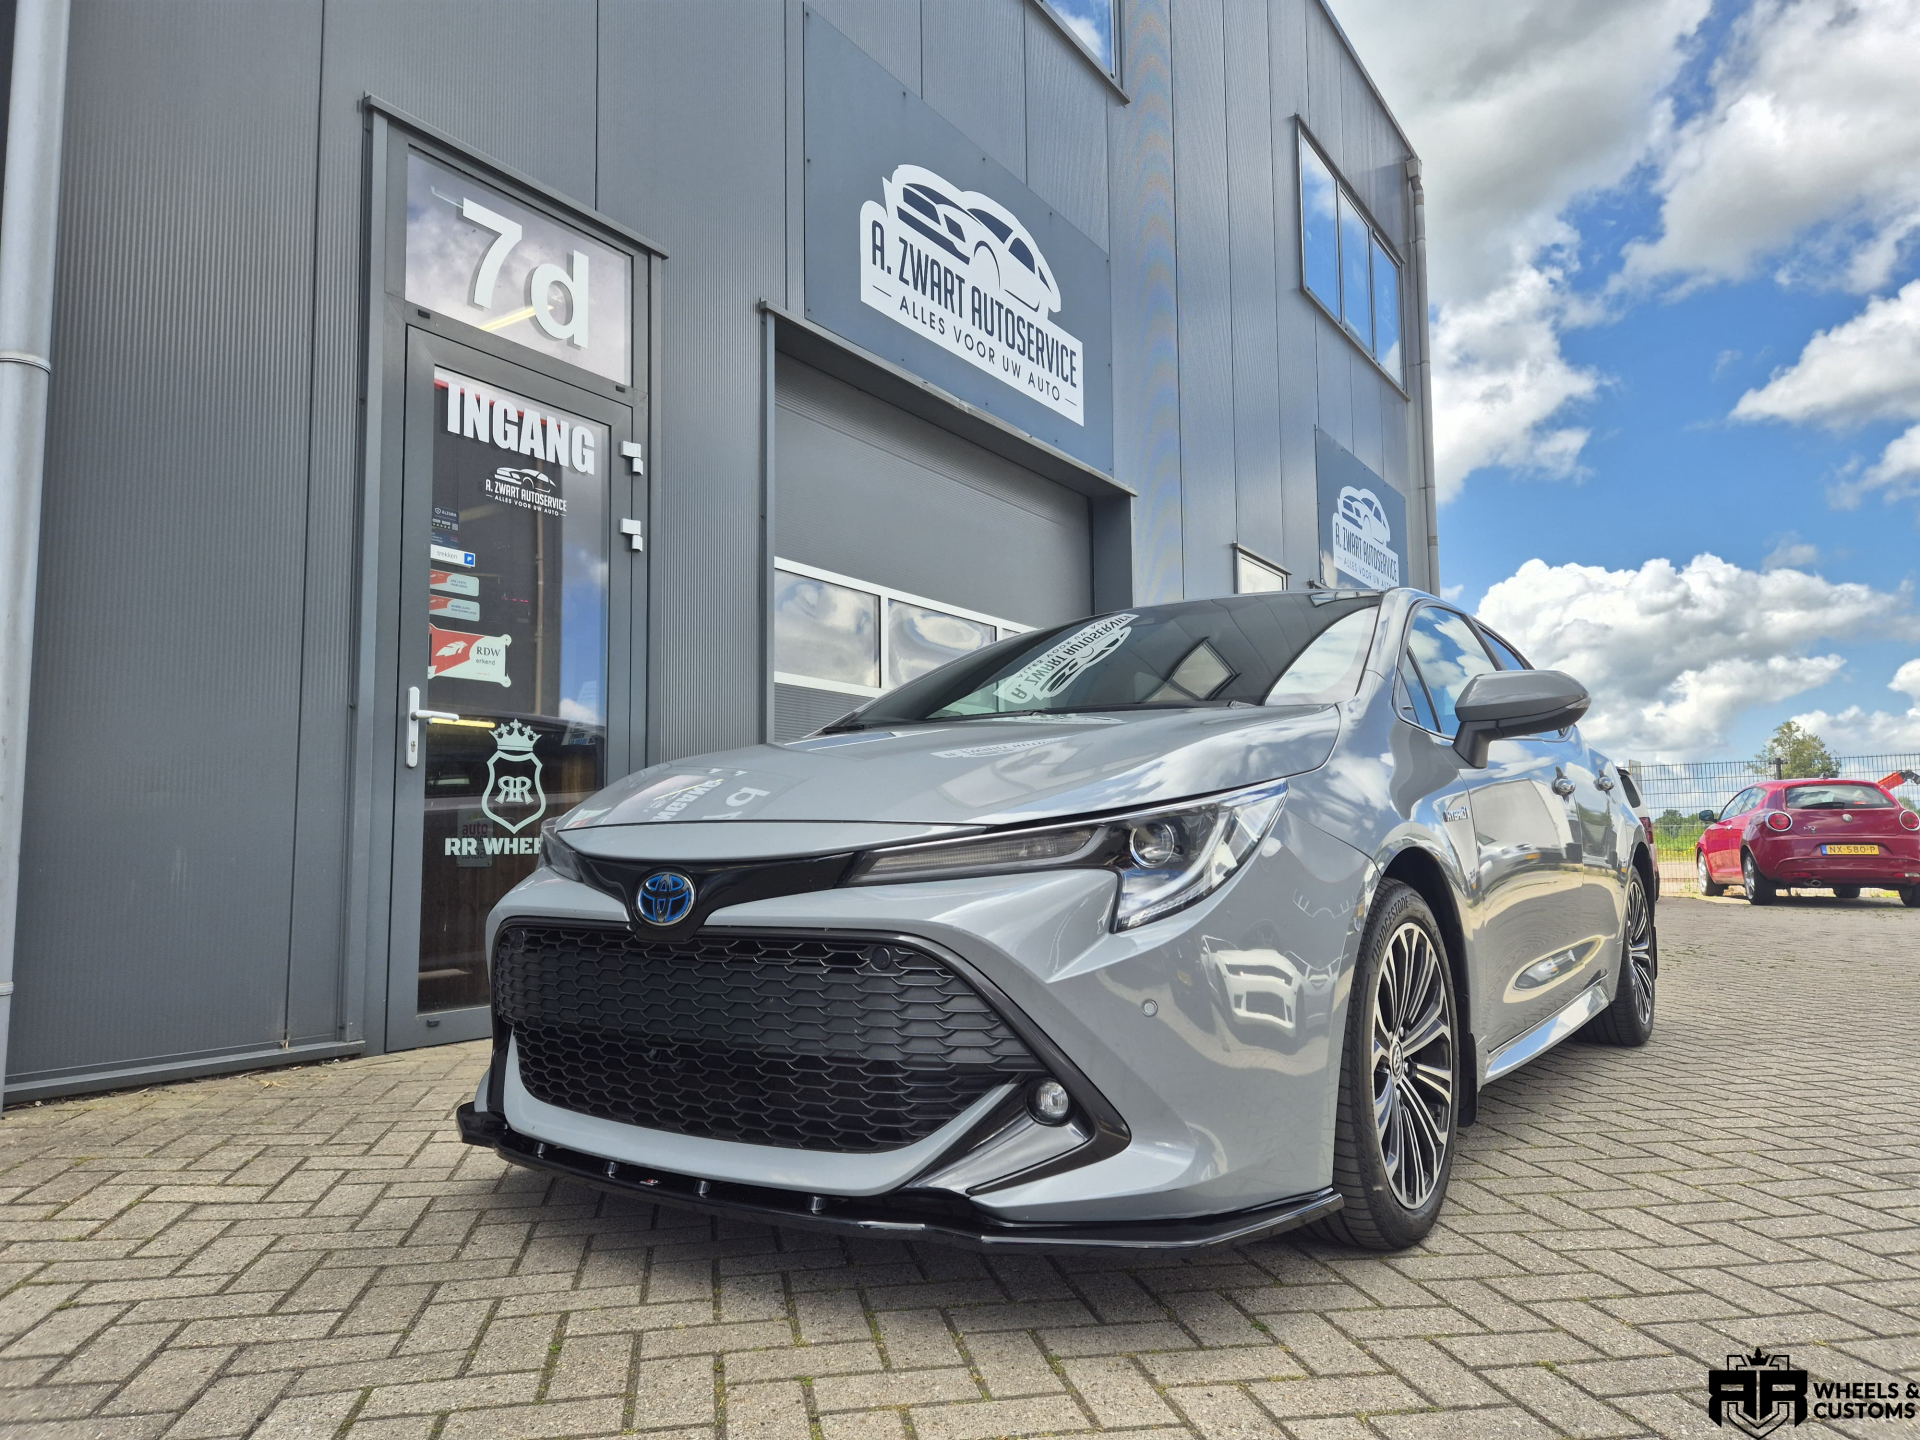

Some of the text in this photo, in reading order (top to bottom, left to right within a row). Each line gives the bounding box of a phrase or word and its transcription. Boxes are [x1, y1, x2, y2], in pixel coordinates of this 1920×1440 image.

[463, 197, 589, 350] 7d
[871, 219, 1077, 389] A. ZWART AUTOSERVICE
[899, 295, 1060, 401] ALLES VOOR UW AUTO
[447, 381, 595, 476] INGANG
[485, 478, 567, 512] A. ZWART AUTOSERVICE
[494, 494, 512, 504] ALLES
[513, 500, 531, 509] VOOR
[543, 508, 559, 517] AUTO
[436, 550, 458, 561] trekken
[1342, 526, 1362, 560] ZWART
[1363, 540, 1397, 583] AUTOSERVICE
[1343, 557, 1358, 572] ALLES
[475, 658, 496, 666] erkend
[476, 646, 501, 657] RDW
[462, 821, 489, 836] auto
[444, 837, 478, 856] RR
[1829, 845, 1876, 854] NX-580-P
[1371, 895, 1410, 970] BRIDGESTONE
